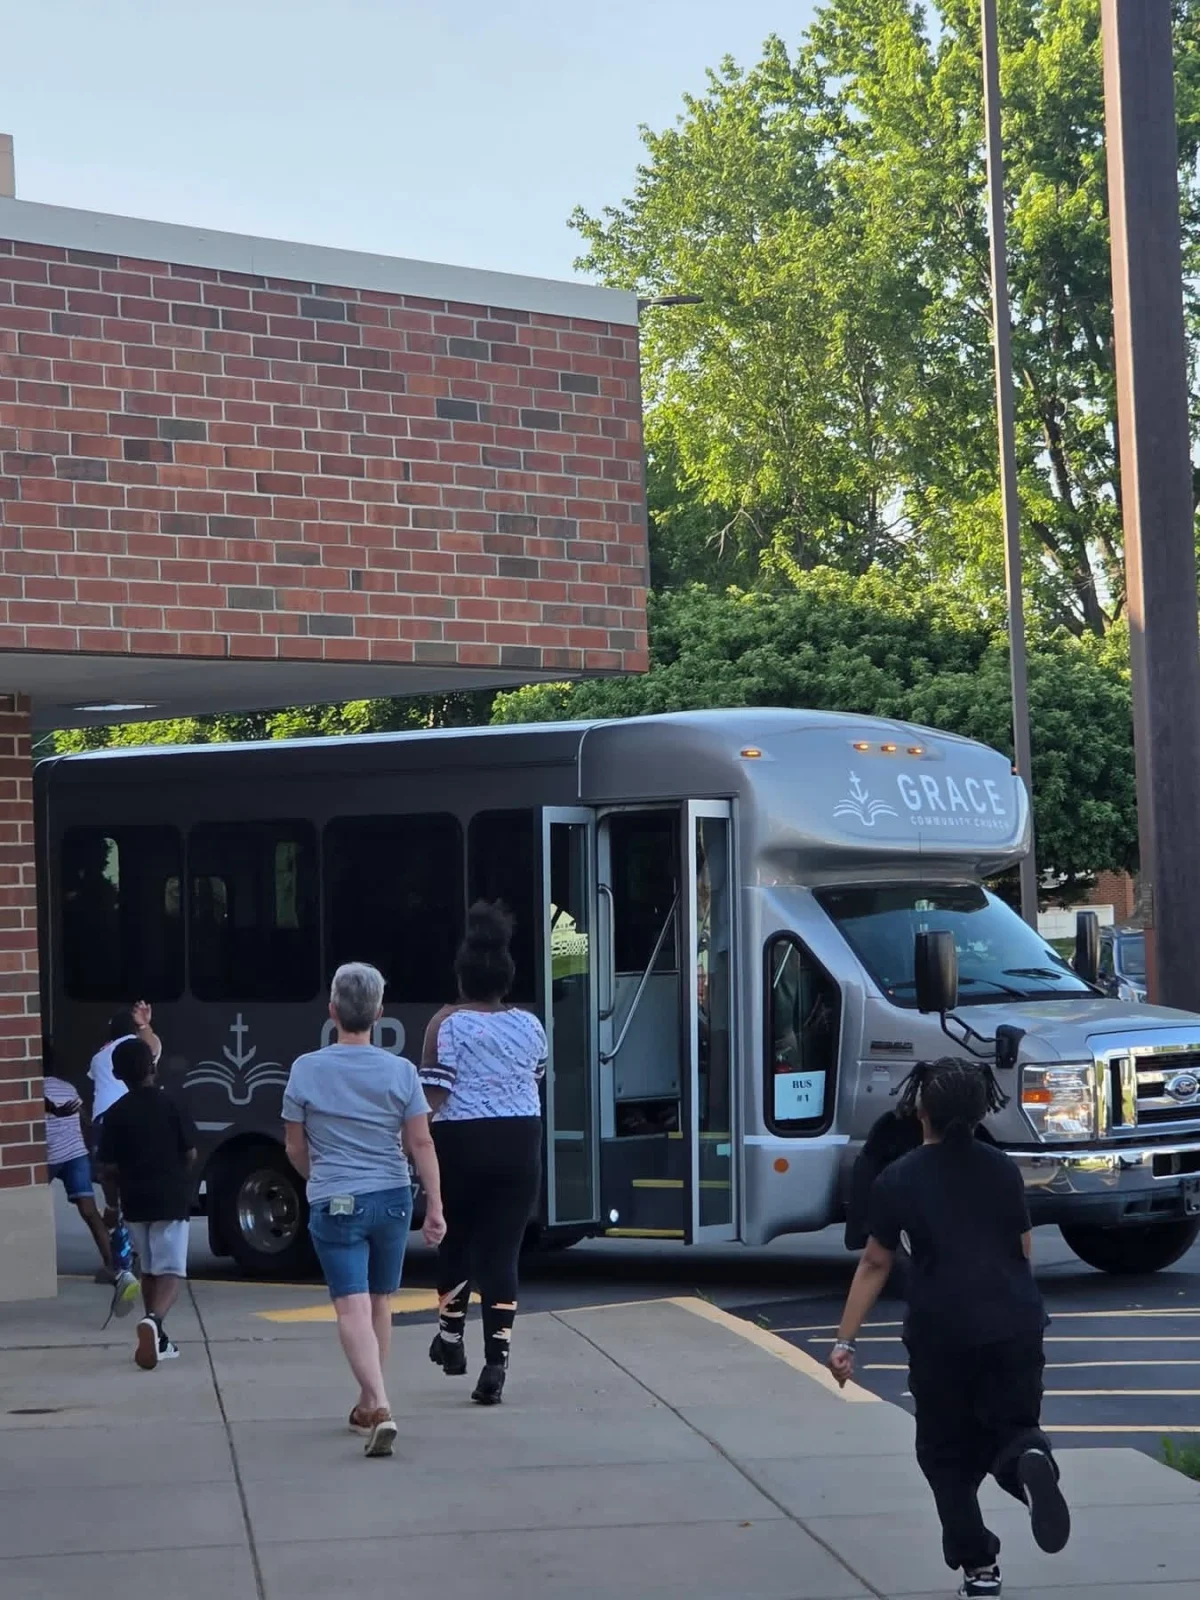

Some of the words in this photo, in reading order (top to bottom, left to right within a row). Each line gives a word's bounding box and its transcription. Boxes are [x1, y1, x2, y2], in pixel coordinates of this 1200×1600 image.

[897, 774, 1006, 815] GRACE
[910, 815, 972, 826] COMMUNITY
[792, 1080, 812, 1089] BUS
